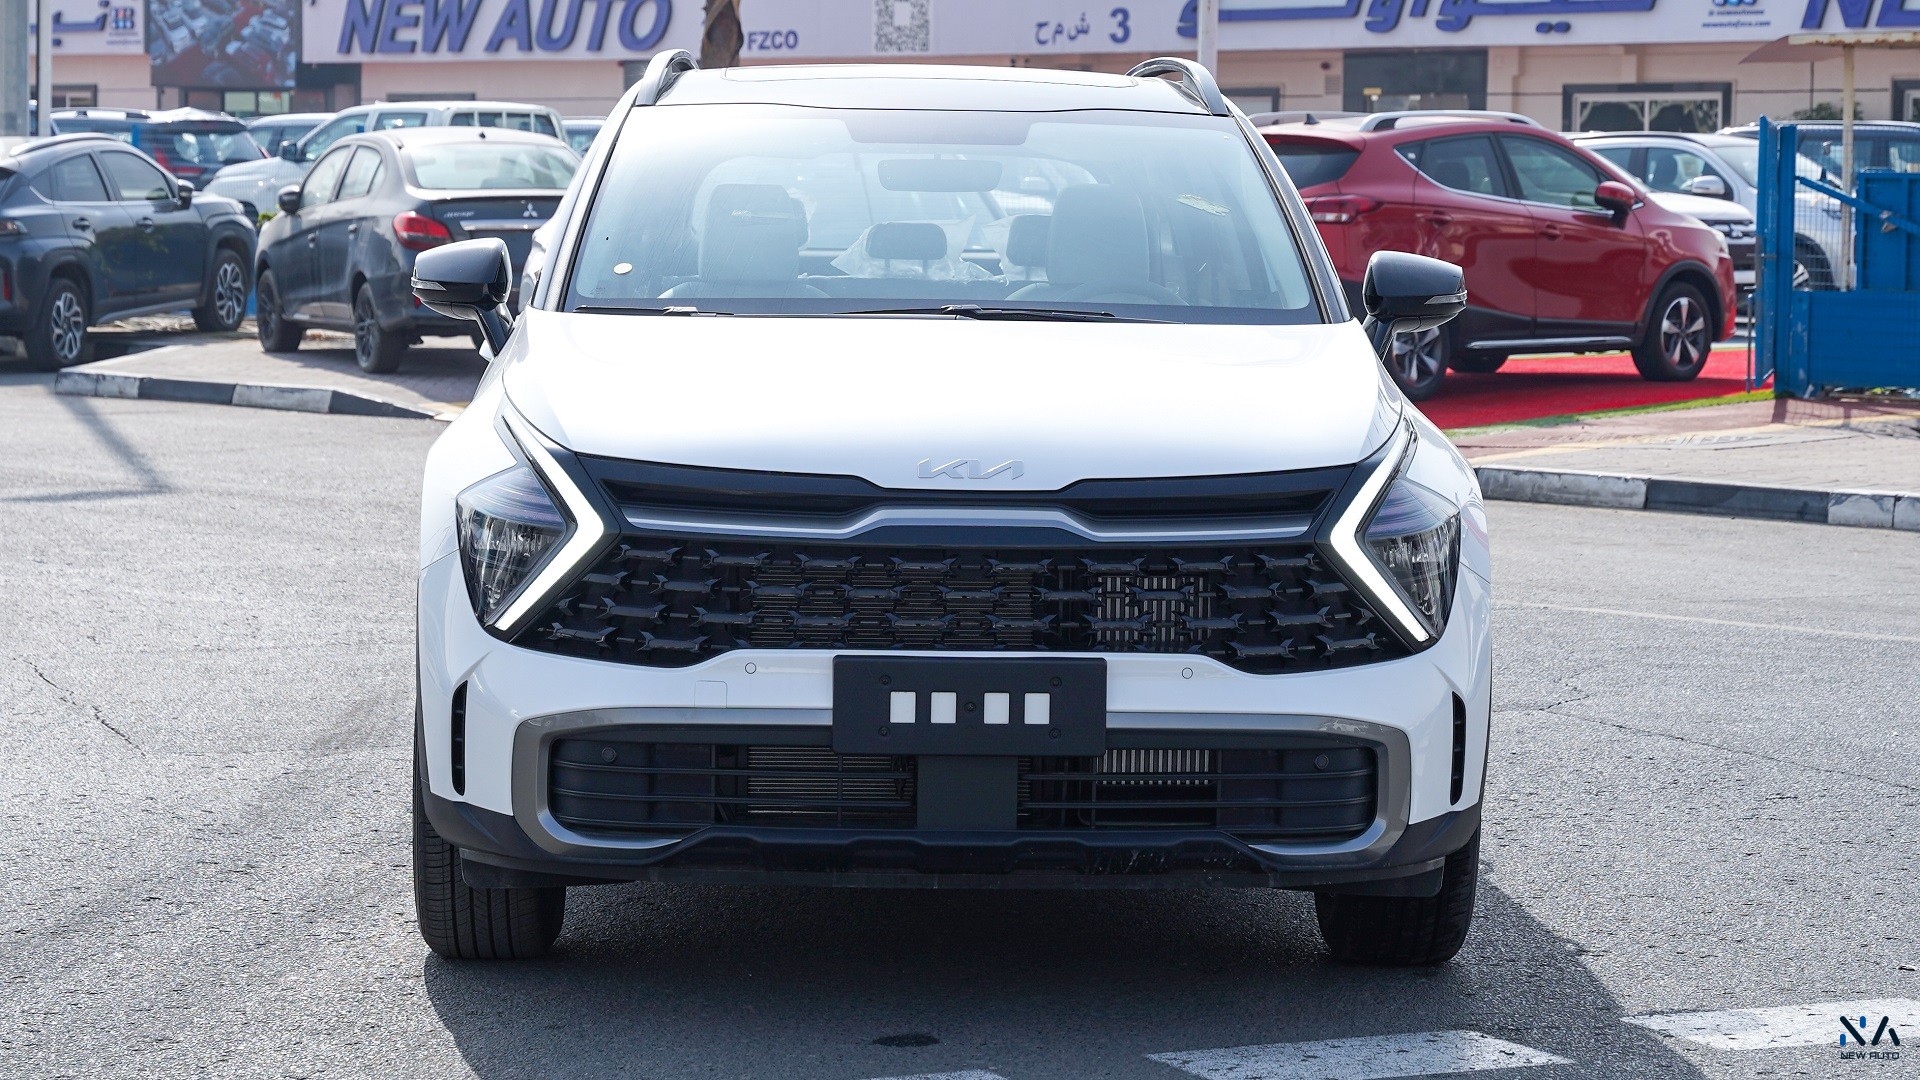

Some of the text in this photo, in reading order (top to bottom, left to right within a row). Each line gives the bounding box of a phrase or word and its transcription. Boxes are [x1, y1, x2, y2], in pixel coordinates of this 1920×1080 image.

[337, 0, 673, 54] NEW AUTO
[747, 29, 798, 51] FZCO
[1109, 7, 1131, 44] 3
